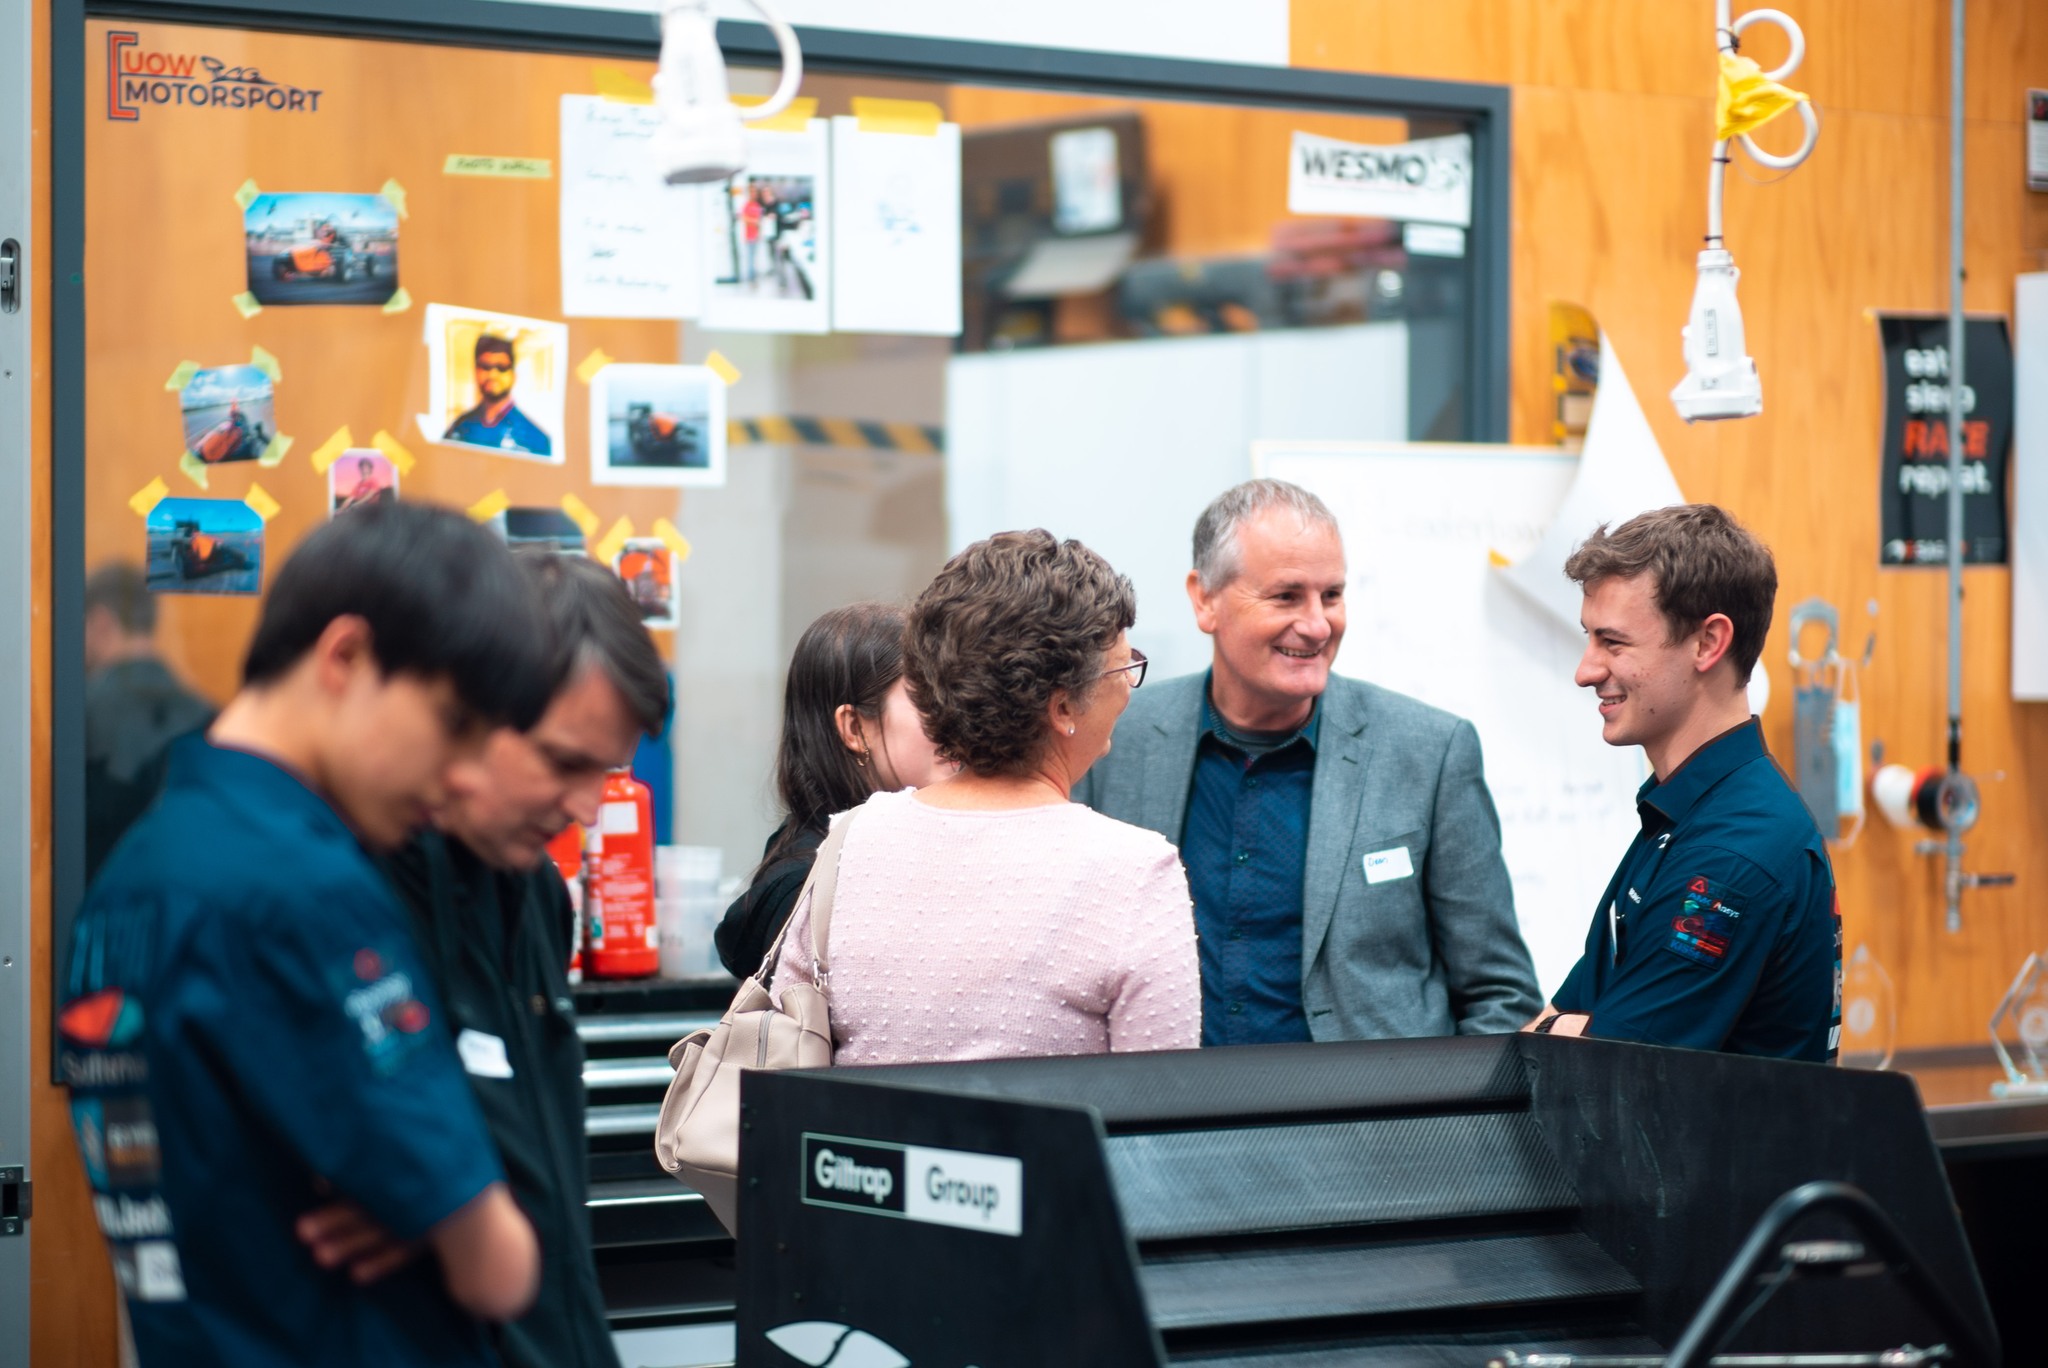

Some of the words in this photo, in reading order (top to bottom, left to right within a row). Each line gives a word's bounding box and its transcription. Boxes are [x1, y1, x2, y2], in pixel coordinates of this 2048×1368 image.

[125, 51, 197, 77] UOW
[125, 80, 323, 112] MOTORSPORT
[1904, 420, 1990, 459] RAE
[814, 1148, 893, 1205] Giltrap
[926, 1164, 1000, 1219] Group
